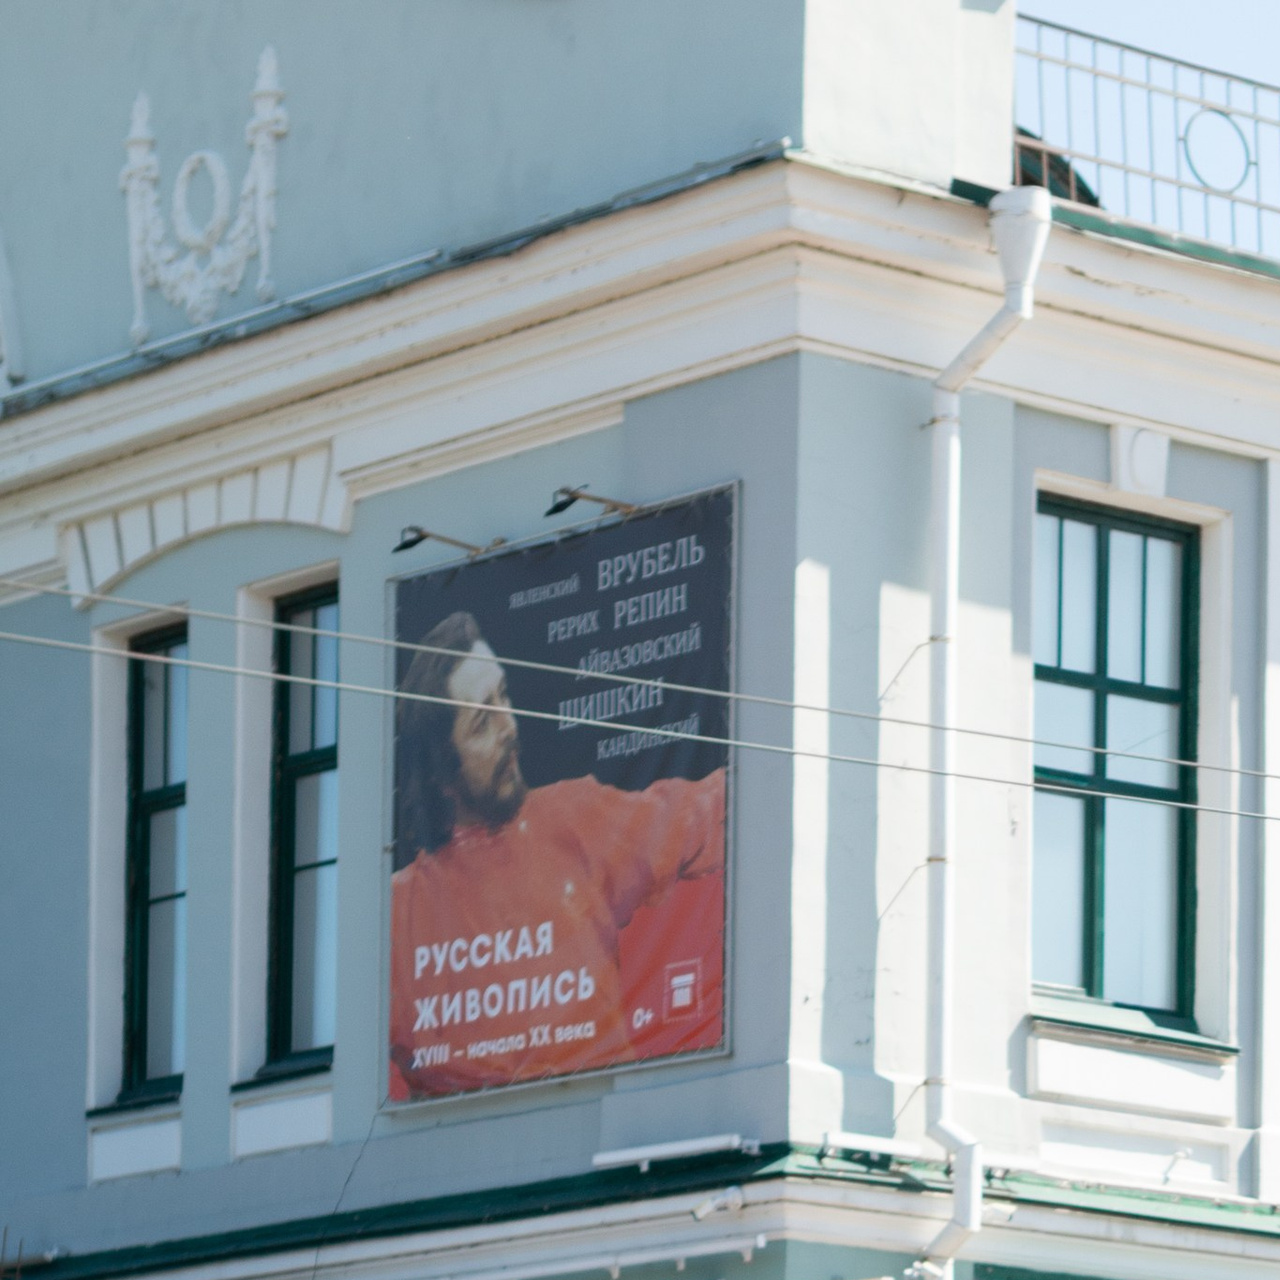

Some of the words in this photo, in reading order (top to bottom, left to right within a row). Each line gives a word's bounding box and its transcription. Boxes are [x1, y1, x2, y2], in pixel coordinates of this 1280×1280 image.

[598, 534, 706, 592] ВРУБЕЛЬ
[548, 609, 600, 644] РЕРИХ
[614, 583, 688, 630] РЕПИН
[574, 621, 701, 681] АЙВАЗОВСКИЙ
[558, 676, 664, 731] ШИШКИН
[597, 712, 700, 761] КАНДИНСКИЙ
[414, 920, 553, 980] РУССКАЯ
[411, 966, 596, 1043] ЖИВОПИСЬ
[411, 1042, 450, 1070] XVIII
[467, 1033, 526, 1060] начала
[529, 1023, 551, 1048] XX
[554, 1020, 596, 1044] века
